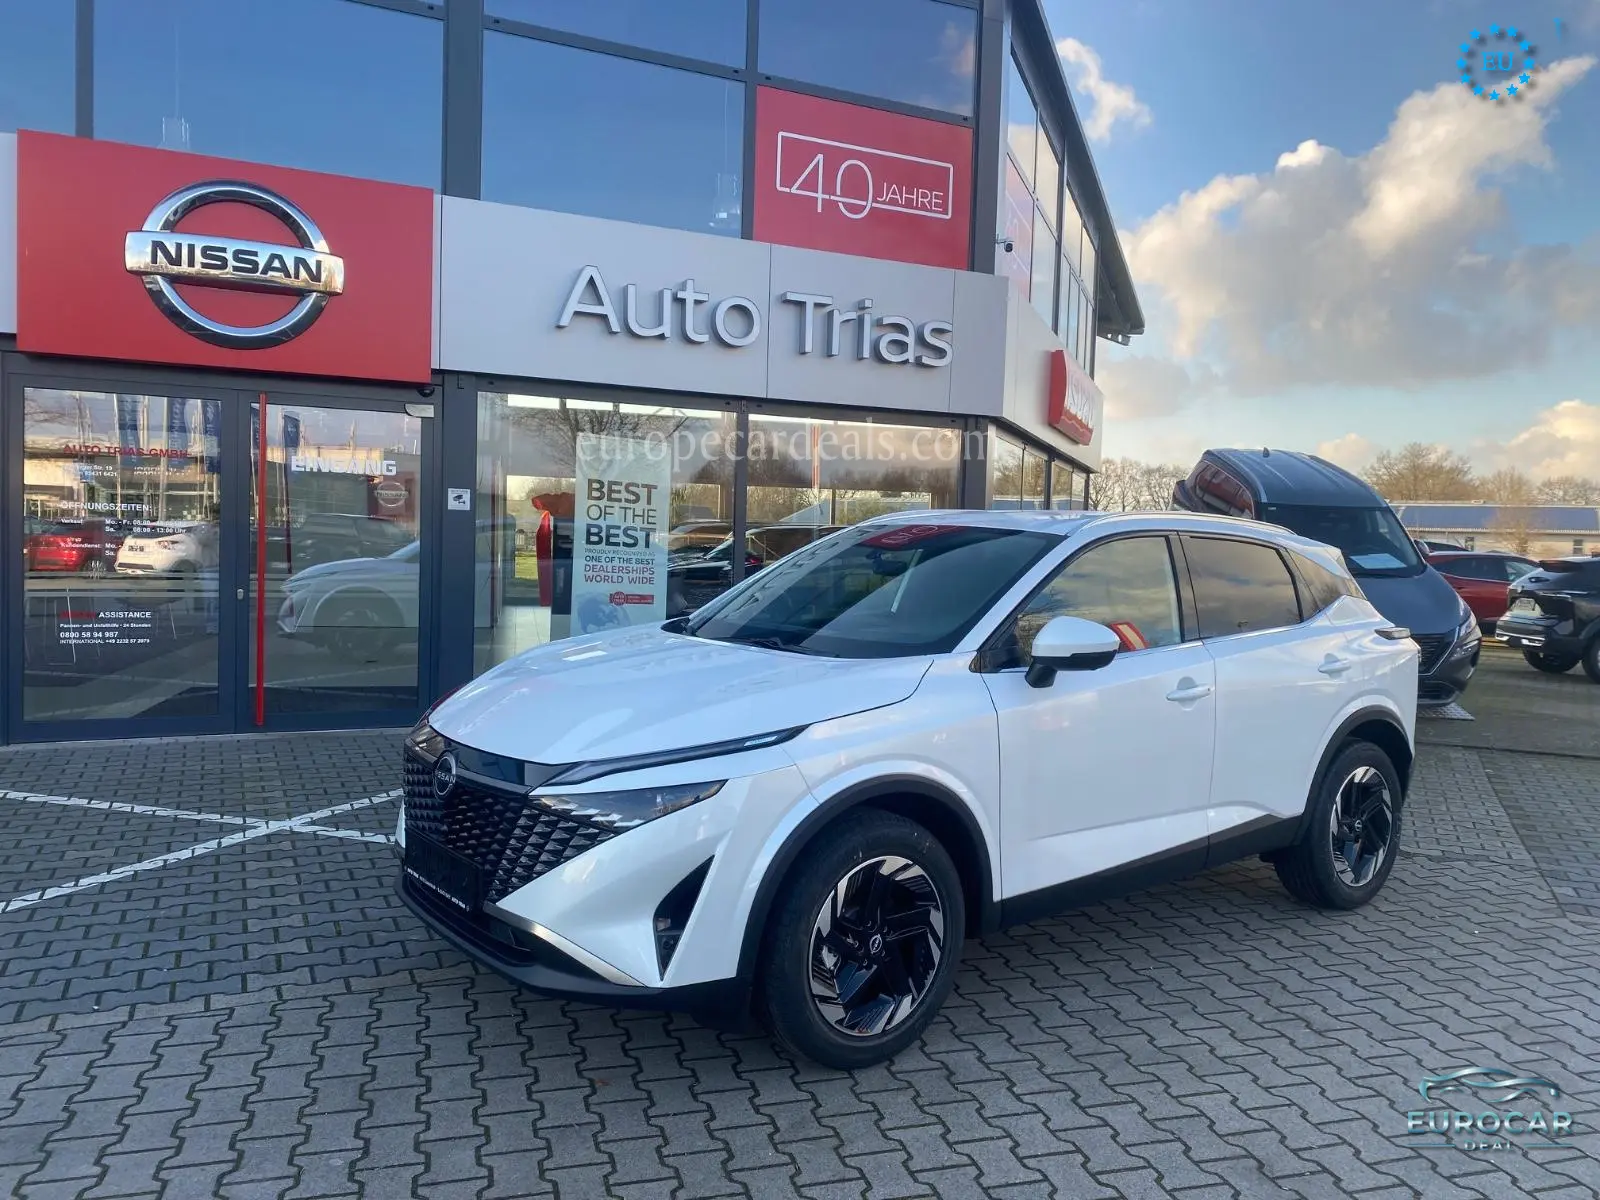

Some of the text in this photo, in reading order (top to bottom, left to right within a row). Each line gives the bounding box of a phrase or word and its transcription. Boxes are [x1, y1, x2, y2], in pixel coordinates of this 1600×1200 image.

[791, 153, 944, 219] 40 JAHRE
[150, 239, 323, 285] NISSAN
[555, 264, 954, 368] Auto Trias
[587, 478, 658, 506] BEST
[586, 504, 657, 525] OF THE
[585, 523, 657, 549] BEST
[583, 564, 655, 575] DEALERSHIPS
[584, 555, 655, 566] ONE OF THE BEST
[583, 574, 655, 585] WORLD WIDE
